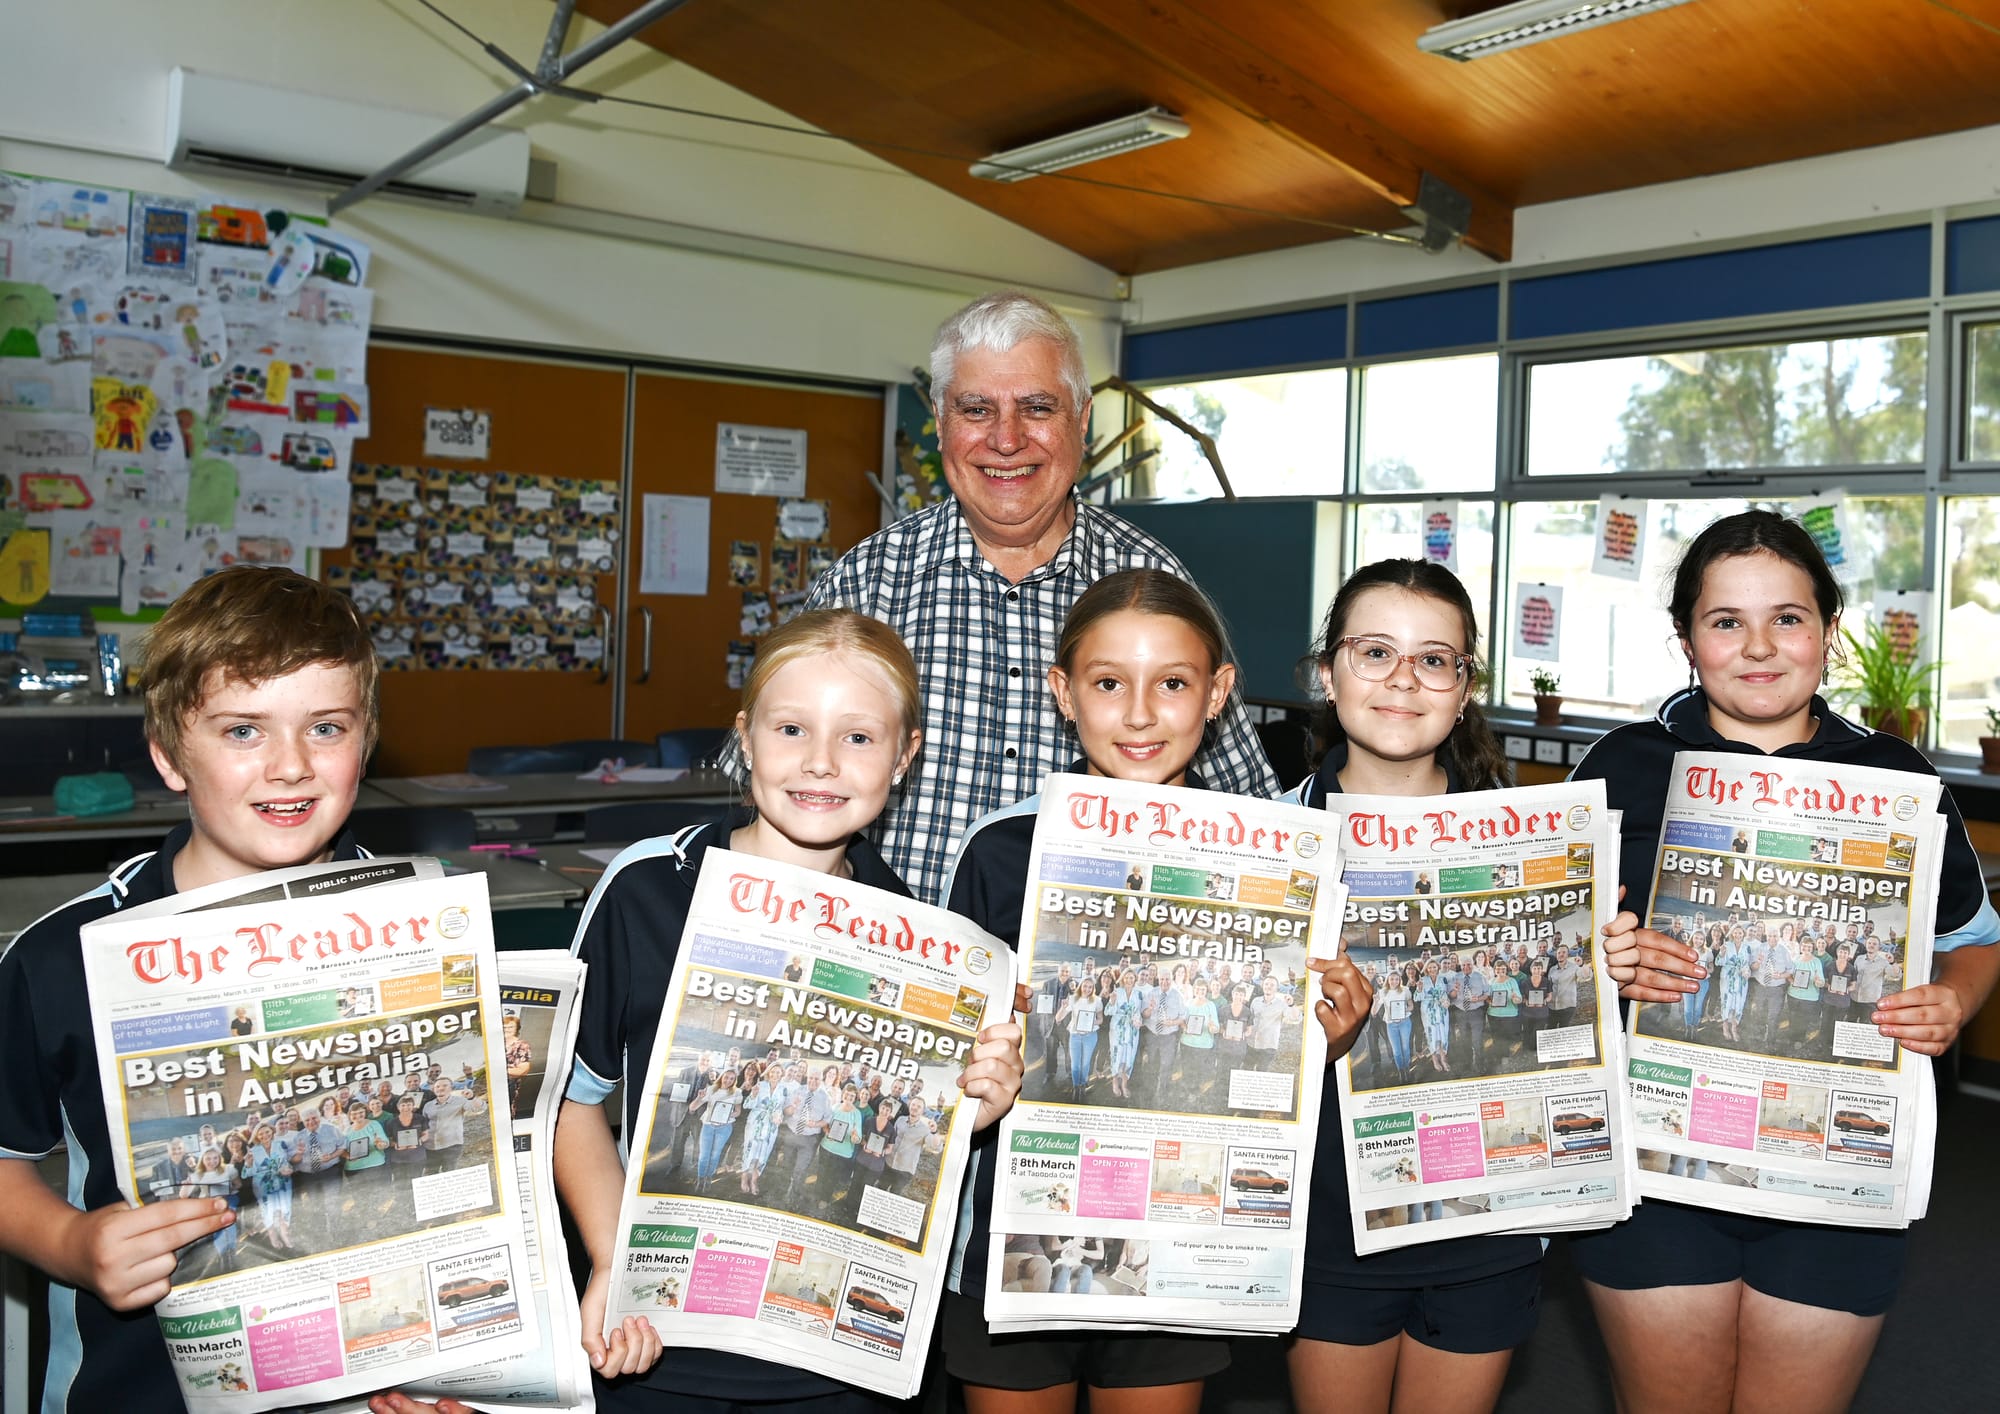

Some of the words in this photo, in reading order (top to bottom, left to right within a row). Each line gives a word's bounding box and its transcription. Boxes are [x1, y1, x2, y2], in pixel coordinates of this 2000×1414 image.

[1686, 766, 1744, 806] The
[1749, 771, 1888, 818] Leader
[1067, 792, 1140, 838] The
[1146, 801, 1290, 853] Leader
[1348, 812, 1418, 852] The
[1422, 805, 1562, 852] Leader
[1699, 824, 1722, 832] Women
[1844, 848, 1864, 856] Home
[1845, 841, 1872, 849] Autumn
[1042, 854, 1088, 866] Inspirational
[1089, 858, 1116, 868] Women
[1065, 864, 1093, 874] Barossa
[1102, 868, 1120, 878] Light
[1153, 874, 1172, 882] Show
[1171, 868, 1200, 878] Tanunda
[1662, 850, 1724, 878] Best
[1732, 858, 1908, 900] Newspaper
[308, 878, 348, 892] PUBLIC
[350, 868, 396, 882] NOTICES
[1344, 901, 1409, 922] Best
[1420, 888, 1590, 920] Newspaper
[1689, 880, 1716, 905] in
[1724, 886, 1867, 922] Australia
[729, 872, 806, 924] The
[814, 892, 960, 966] Leader
[1040, 887, 1116, 918] Best
[1126, 896, 1308, 938] Newspaper
[1378, 928, 1406, 948] in
[1416, 918, 1554, 946] Australia
[126, 936, 230, 985] The
[235, 912, 430, 978] Leader
[695, 935, 744, 951] Inspirational
[745, 944, 774, 957] Women
[1079, 922, 1108, 949] in
[1117, 926, 1263, 962] Australia
[396, 948, 434, 958] Newspaper
[718, 948, 749, 961] Barossa
[757, 955, 778, 966] Light
[815, 968, 835, 979] Show
[833, 963, 864, 980] Tanunda
[383, 978, 420, 988] Autumn
[288, 992, 328, 1004] Tanunda
[384, 986, 412, 998] Home
[502, 988, 552, 1002] ralia
[908, 985, 938, 998] Autumn
[906, 994, 930, 1005] Home
[112, 1016, 172, 1030] Inspirational
[174, 1010, 212, 1022] Women
[265, 1008, 292, 1019] Show
[687, 970, 770, 1009] Best
[780, 987, 972, 1060] Newspaper
[145, 1024, 183, 1036] Barossa
[194, 1018, 220, 1030] Light
[124, 1047, 226, 1088] Best
[238, 1008, 478, 1072] Newspaper
[724, 1010, 756, 1040] in
[766, 1020, 919, 1080] Australia
[1632, 1063, 1649, 1075] This
[1648, 1066, 1690, 1082] Weekend
[184, 1087, 224, 1116] in
[238, 1051, 430, 1108] Australia
[1732, 1081, 1757, 1091] pharmacy
[1636, 1083, 1654, 1094] 8th
[1656, 1087, 1688, 1100] March
[1703, 1092, 1722, 1100] OPEN
[1728, 1096, 1747, 1104] DAYS
[1551, 1098, 1571, 1106] SANTA
[1643, 1094, 1672, 1104] Tanunda
[1672, 1098, 1688, 1108] Oval
[1837, 1094, 1858, 1102] SANTA
[1868, 1098, 1891, 1106] Hybrid.
[1453, 1111, 1476, 1119] pharmacy
[1357, 1122, 1373, 1134] This
[1373, 1117, 1412, 1132] Weekend
[1452, 1126, 1470, 1134] DAYS
[1015, 1134, 1032, 1146] This
[1033, 1136, 1078, 1150] Weekend
[1123, 1144, 1148, 1152] pharmacy
[1156, 1144, 1178, 1152] DESIGN
[1365, 1140, 1382, 1150] 8th
[1384, 1136, 1414, 1148] March
[1234, 1150, 1256, 1158] SANTA
[1266, 1154, 1290, 1162] Hybrid.
[1374, 1149, 1400, 1158] Tanunda
[1402, 1146, 1416, 1154] Oval
[1020, 1158, 1038, 1168] 8th
[1041, 1159, 1076, 1170] March
[1092, 1159, 1112, 1168] OPEN
[1119, 1160, 1138, 1168] DAYS
[1059, 1171, 1075, 1179] Oval
[634, 1229, 648, 1242] This
[650, 1230, 694, 1244] Weekend
[718, 1238, 742, 1247] priceline
[743, 1241, 770, 1252] pharmacy
[778, 1245, 801, 1257] DESIGN
[1173, 1240, 1188, 1248] Find
[1188, 1242, 1202, 1250] your
[1218, 1242, 1224, 1250] to
[435, 1261, 462, 1273] SANTA
[474, 1251, 503, 1266] Hybrid.
[635, 1254, 652, 1263] 8th
[654, 1254, 689, 1265] March
[708, 1254, 728, 1263] OPEN
[736, 1257, 756, 1267] DAYS
[670, 1266, 688, 1274] Oval
[854, 1268, 876, 1280] SANTA
[886, 1277, 910, 1292] Hybrid.
[339, 1282, 369, 1294] DESIGN
[269, 1302, 298, 1314] priceline
[298, 1294, 331, 1308] pharmacy
[163, 1321, 181, 1335] This
[182, 1313, 238, 1335] Weekend
[262, 1324, 288, 1336] OPEN
[299, 1314, 322, 1328] DAYS
[176, 1342, 198, 1354] 8th
[198, 1338, 242, 1352] March
[863, 1340, 880, 1351] 8562
[880, 1345, 900, 1357] 4444
[187, 1353, 223, 1364] Tanunda
[224, 1350, 244, 1360] Oval
